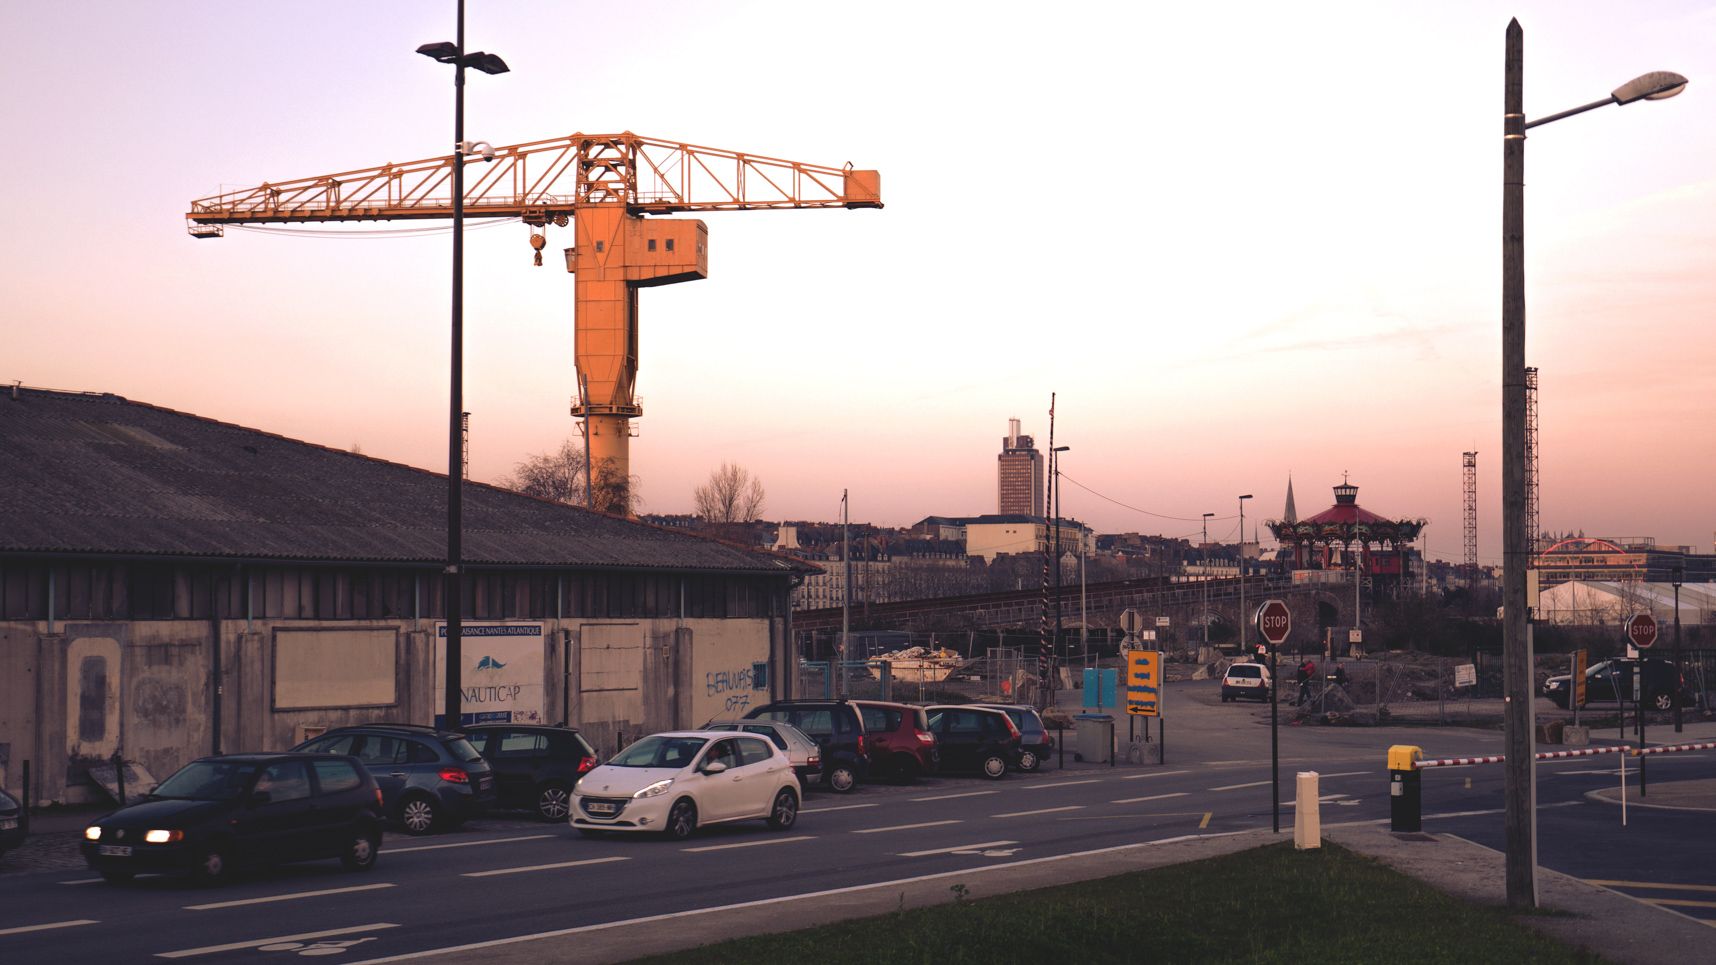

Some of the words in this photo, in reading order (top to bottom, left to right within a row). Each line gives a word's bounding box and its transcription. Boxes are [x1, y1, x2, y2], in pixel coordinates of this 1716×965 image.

[1264, 615, 1287, 628] STOP
[461, 627, 485, 635] AISANCE
[486, 627, 507, 635] NANTES
[508, 626, 540, 636] ATLANTIQUE
[1633, 624, 1654, 635] STOP
[460, 685, 521, 704] NAUTICAP
